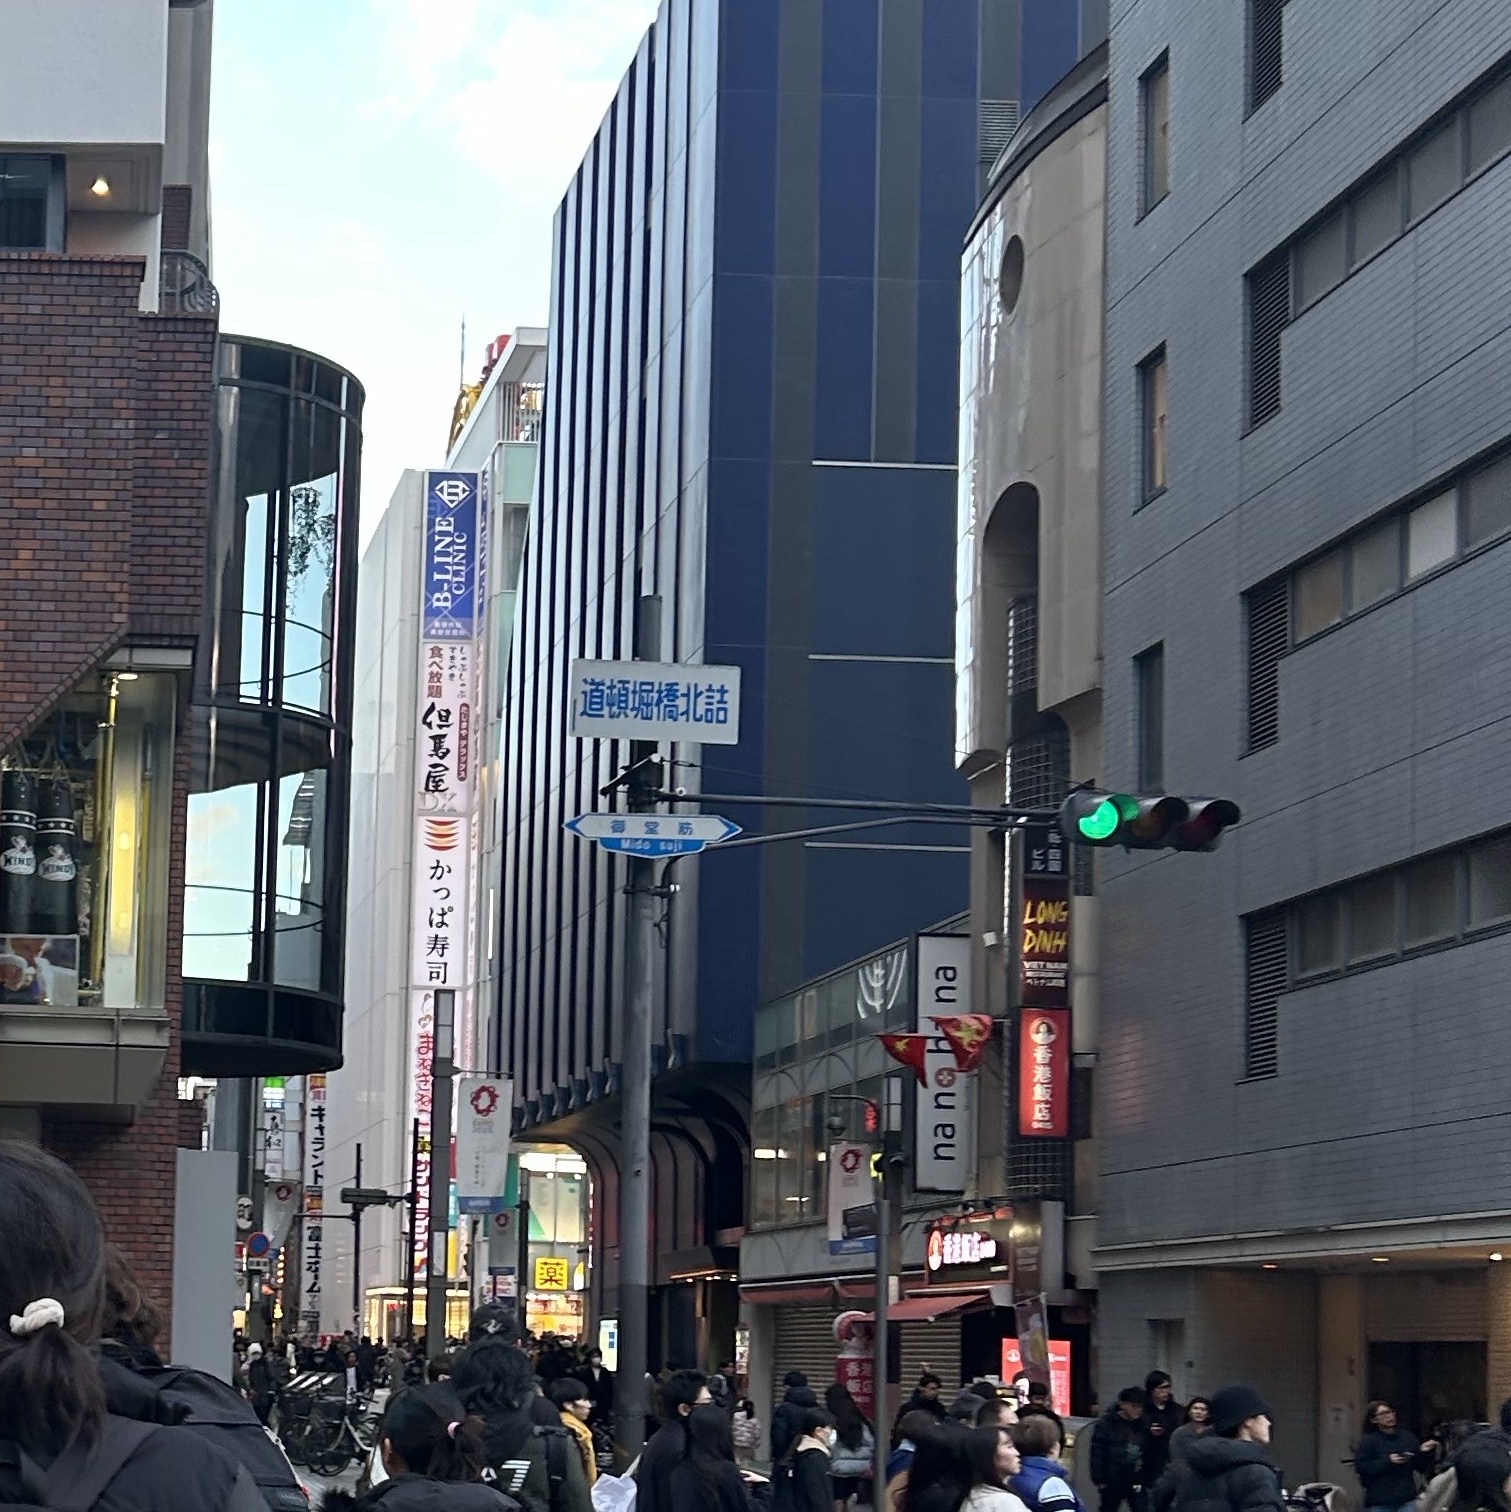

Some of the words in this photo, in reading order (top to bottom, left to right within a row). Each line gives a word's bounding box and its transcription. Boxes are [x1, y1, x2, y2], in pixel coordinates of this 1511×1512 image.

[432, 516, 455, 609] B-LINE
[452, 532, 467, 595] CLINIC
[427, 645, 444, 699] 食べ放題
[580, 678, 729, 724] 道頓堀橋北詰
[422, 701, 454, 793] 但馬屋
[426, 859, 454, 985] かっぱ寿司
[538, 1261, 564, 1286] 薬
